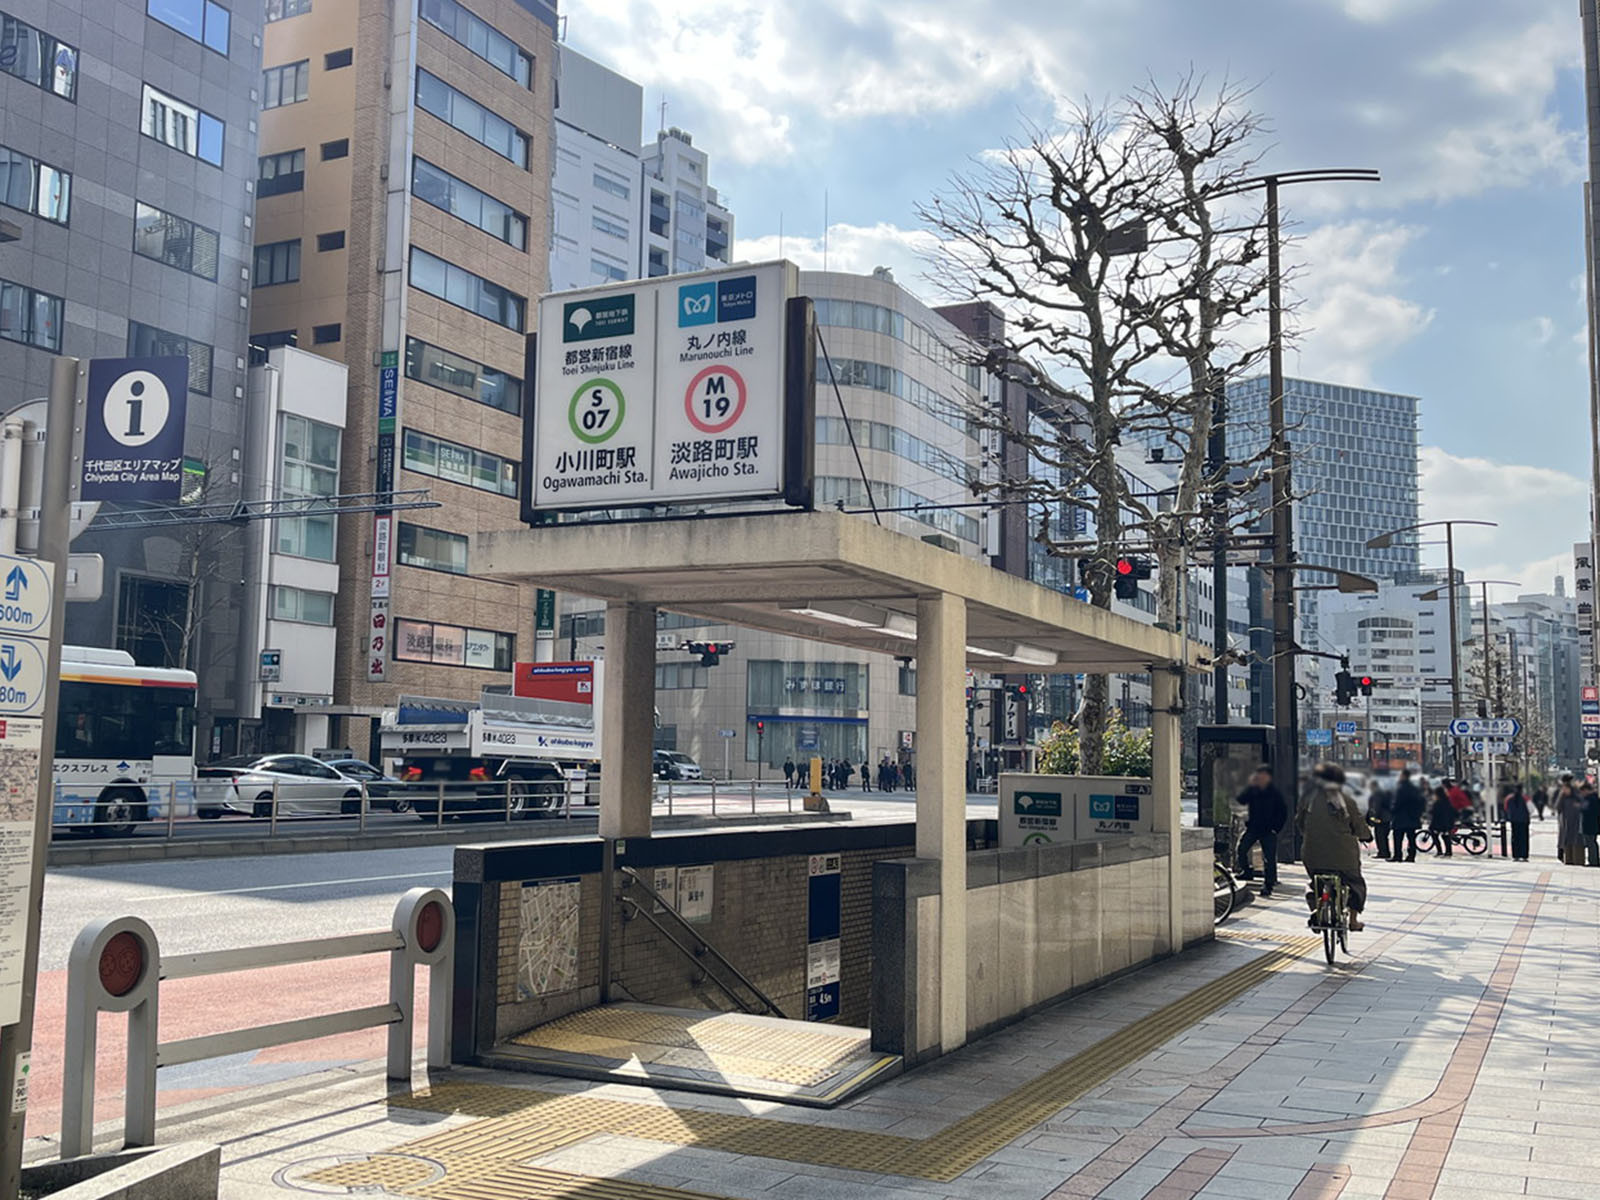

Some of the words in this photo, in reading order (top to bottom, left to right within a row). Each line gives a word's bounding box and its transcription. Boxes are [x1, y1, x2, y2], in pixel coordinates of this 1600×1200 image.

[687, 329, 747, 351] 丸ノ内線
[565, 344, 633, 366] 都営新宿線
[680, 348, 732, 363] Marunouchi
[734, 345, 754, 356] Line
[562, 366, 578, 376] Toei
[580, 363, 616, 375] Shinjuku
[617, 360, 635, 370] Line
[383, 369, 395, 417] SEIWA
[705, 376, 726, 396] M
[592, 389, 602, 407] S
[703, 397, 730, 418] 19
[582, 408, 610, 430] 07
[555, 447, 636, 473] 小川町駅
[670, 436, 758, 464] 淡路町駅
[85, 458, 182, 473] 千代田区エリアマップ
[669, 465, 729, 482] Awajicho
[734, 461, 759, 476] Sta.
[85, 472, 120, 485] Chiyoda
[121, 472, 138, 483] City
[139, 472, 160, 482] Area
[161, 471, 181, 483] Map
[543, 472, 621, 492] Ogawamachi
[624, 470, 648, 485] Sta.
[371, 614, 386, 675] 日乃出
[785, 678, 846, 693] みずほ銀行
[52, 764, 109, 773] エクスプレス
